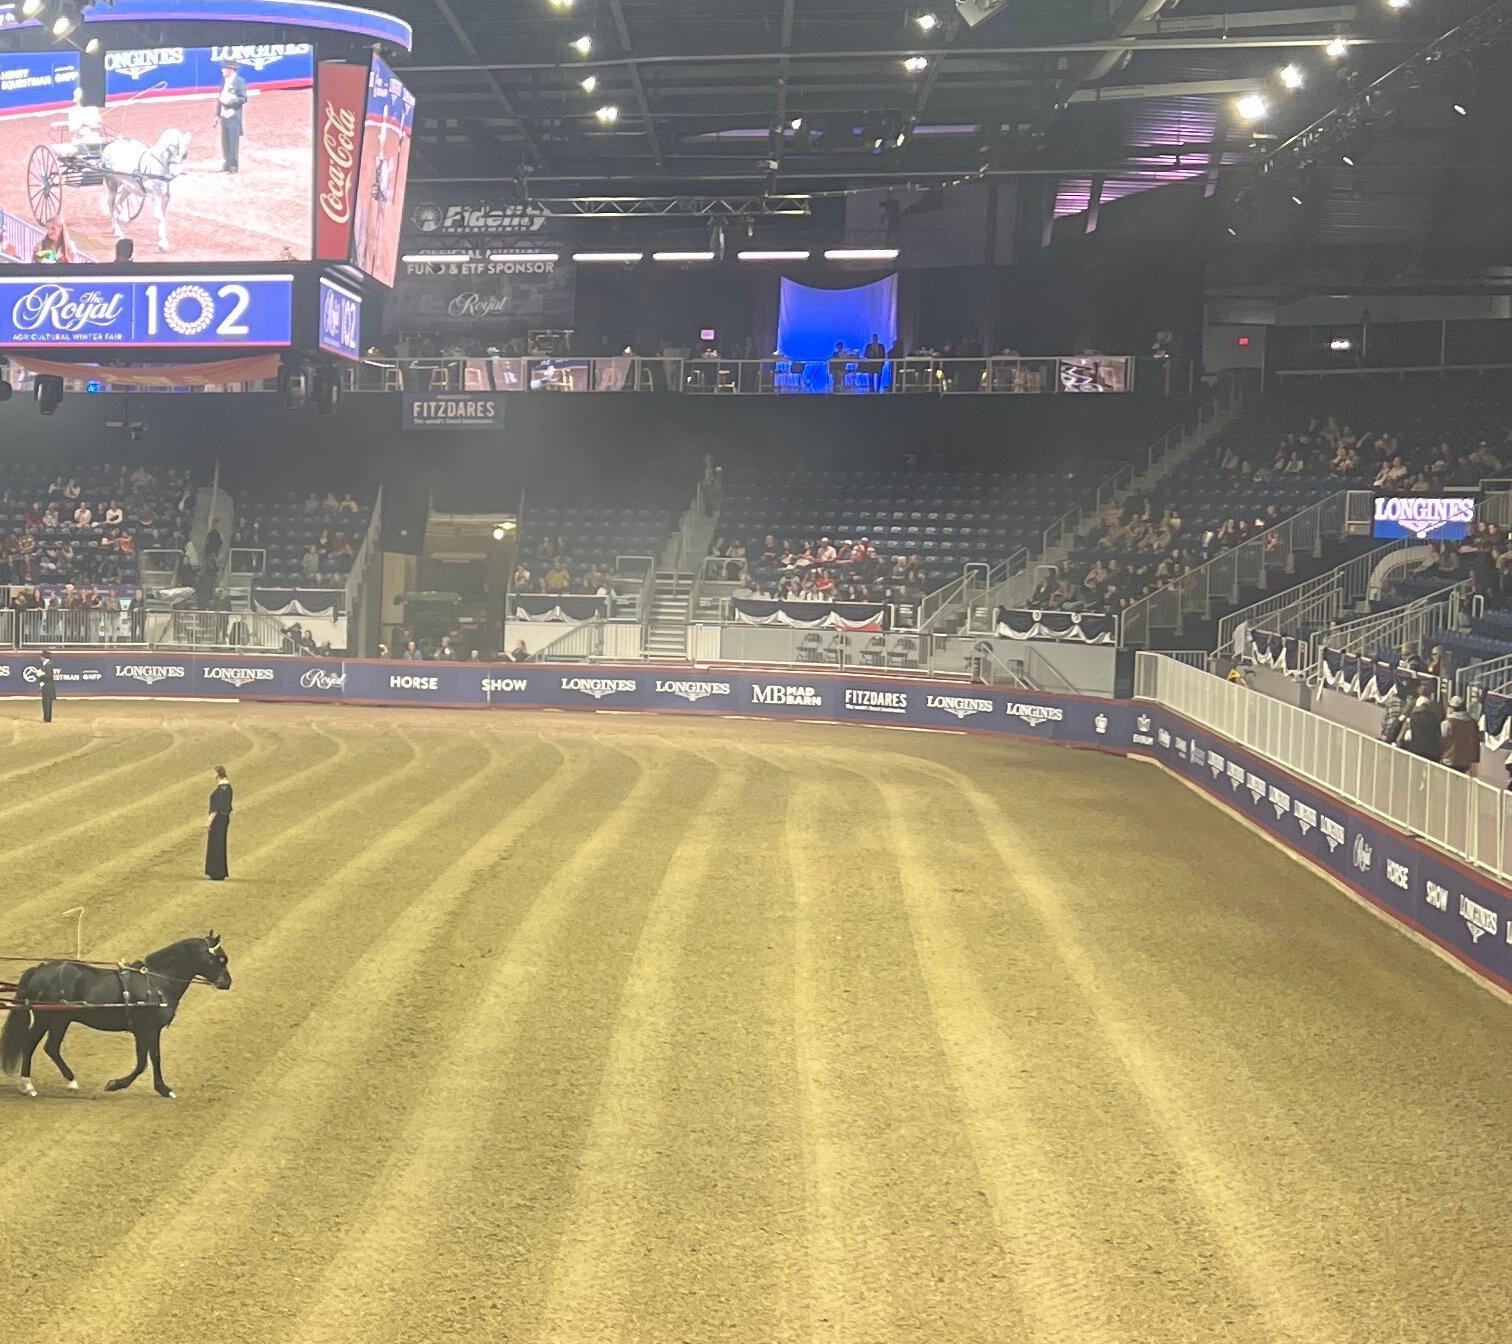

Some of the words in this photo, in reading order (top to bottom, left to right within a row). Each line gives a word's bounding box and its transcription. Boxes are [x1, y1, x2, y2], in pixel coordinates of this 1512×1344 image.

[105, 47, 183, 70] ONGINES
[443, 205, 546, 231] Fidelity
[462, 263, 485, 274] ETF
[488, 262, 554, 274] SPONSOR
[12, 284, 125, 331] Royal
[145, 284, 250, 336] 102
[448, 292, 508, 317] Royal
[413, 402, 495, 417] FITZDARES
[1375, 498, 1475, 522] LONGINES
[116, 666, 185, 680] LONGINES
[204, 667, 274, 681] LONGINES
[390, 676, 438, 690] HORSE
[482, 677, 527, 692] SHOW
[561, 678, 636, 692] LONGINES
[656, 680, 730, 695] LONGINES
[752, 685, 786, 704] MB
[787, 687, 815, 696] MAD
[787, 695, 822, 706] BARN
[845, 689, 907, 707] FITZDARES
[927, 695, 993, 712] LONGINES
[1006, 702, 1063, 721] LONGINES
[1460, 894, 1498, 936] LONGINES
